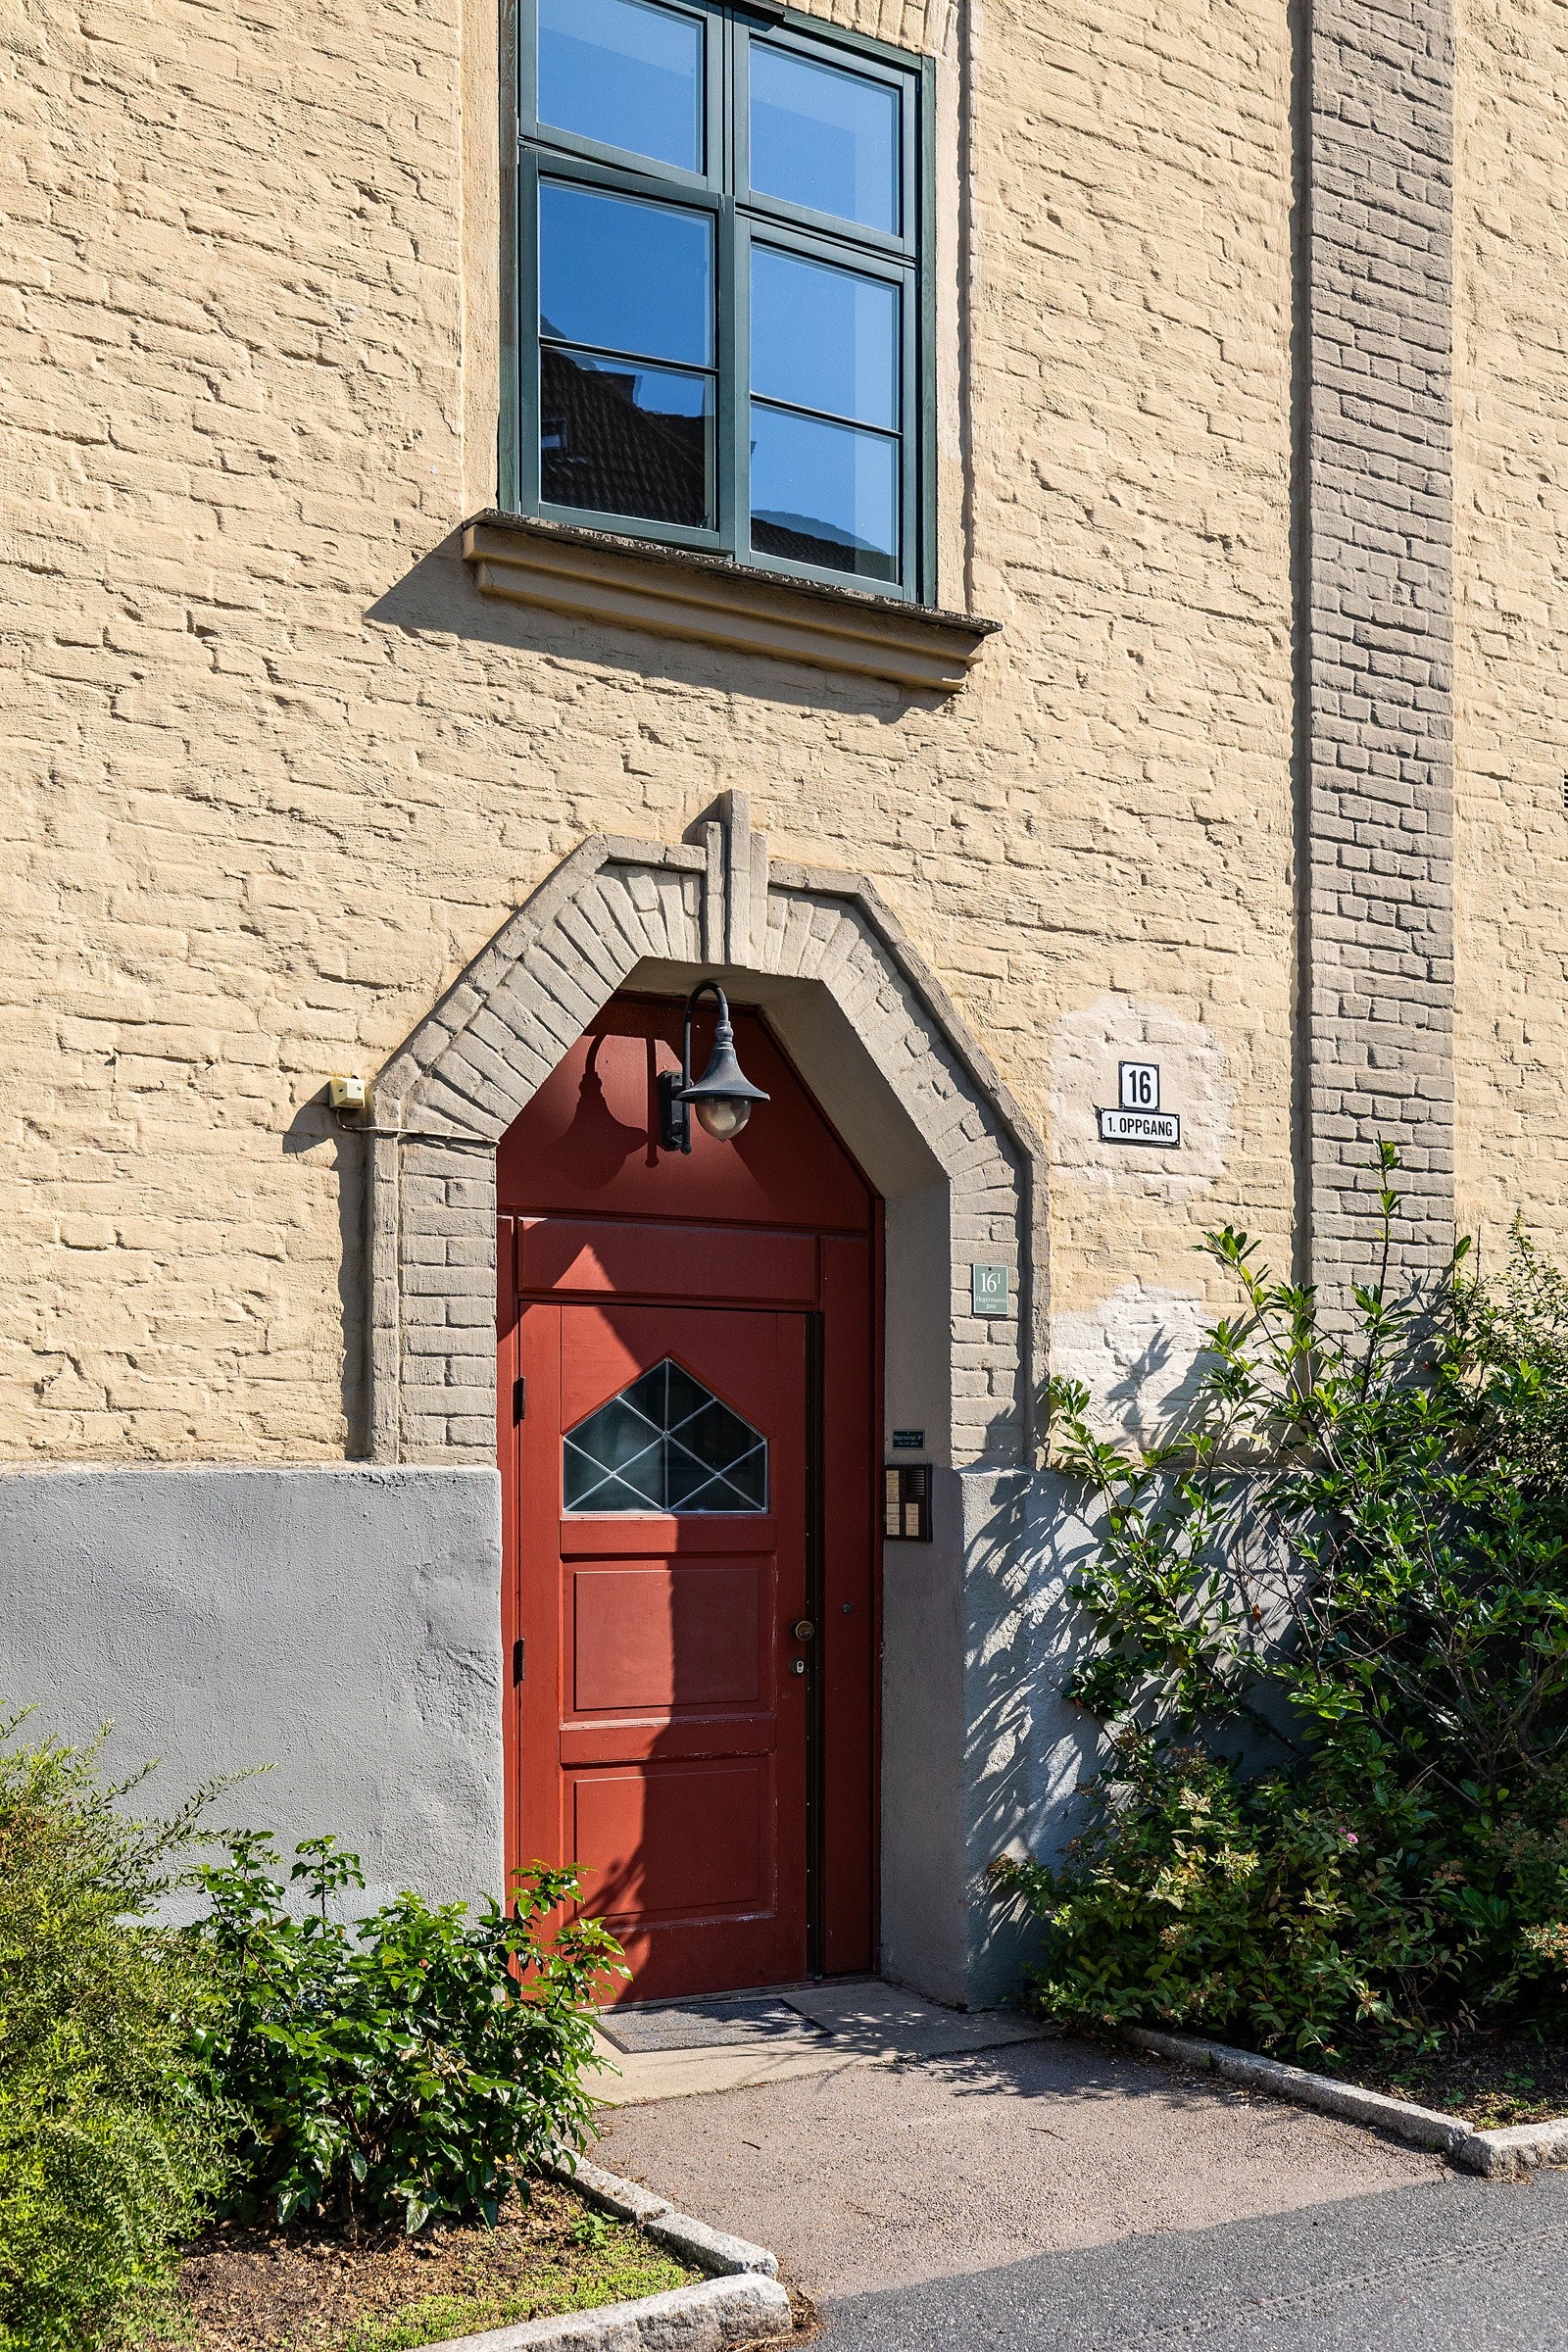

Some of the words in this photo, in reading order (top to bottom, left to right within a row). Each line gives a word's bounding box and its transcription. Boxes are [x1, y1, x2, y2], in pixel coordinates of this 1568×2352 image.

[1129, 1070, 1152, 1103] 16
[1107, 1117, 1116, 1132] 1.
[1119, 1117, 1173, 1137] OPPGANG
